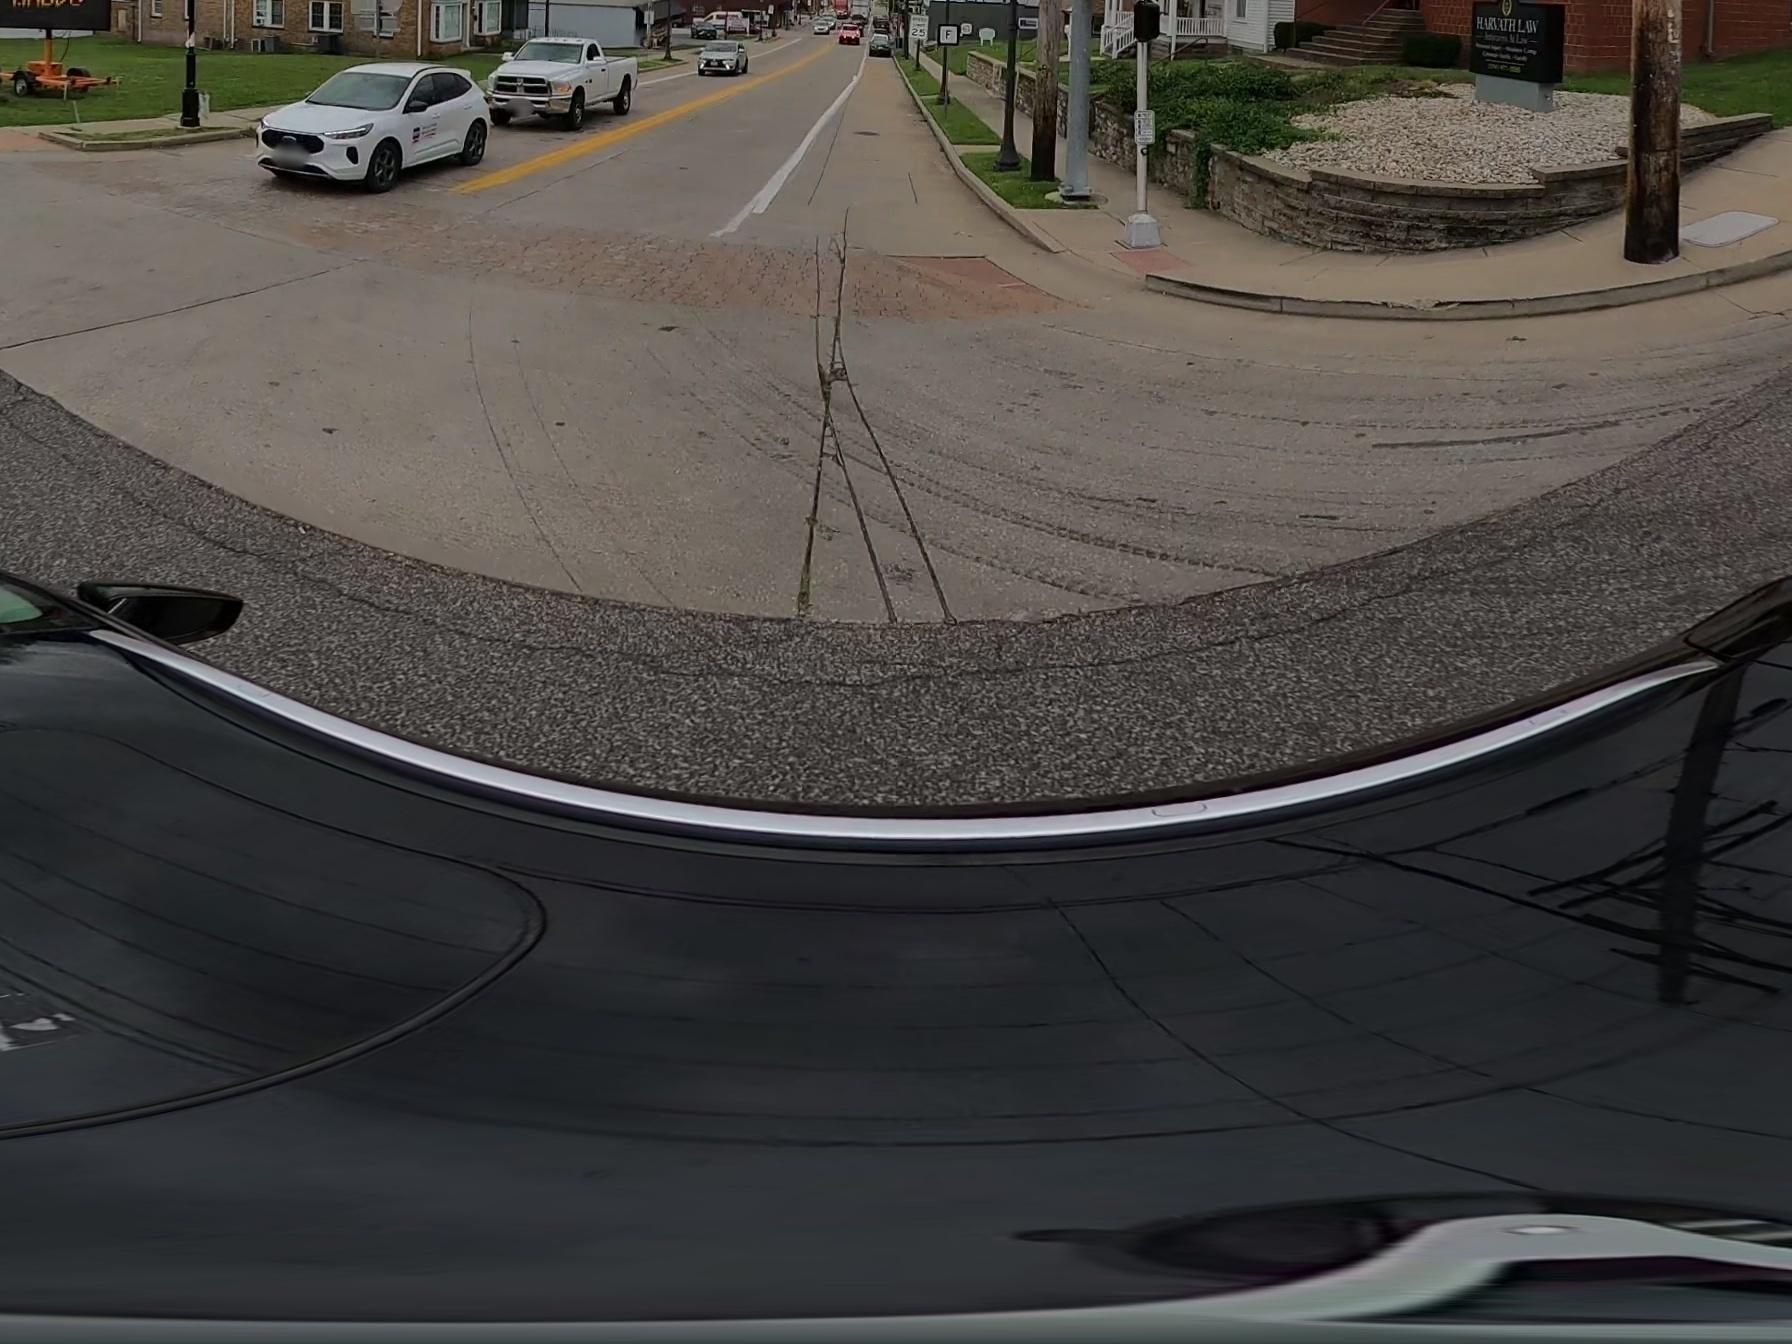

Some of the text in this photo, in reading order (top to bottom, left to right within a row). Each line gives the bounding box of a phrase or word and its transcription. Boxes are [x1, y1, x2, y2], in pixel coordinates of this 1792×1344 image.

[1476, 16, 1540, 34] HARVATH LAW
[911, 28, 926, 37] 25
[945, 30, 952, 40] F
